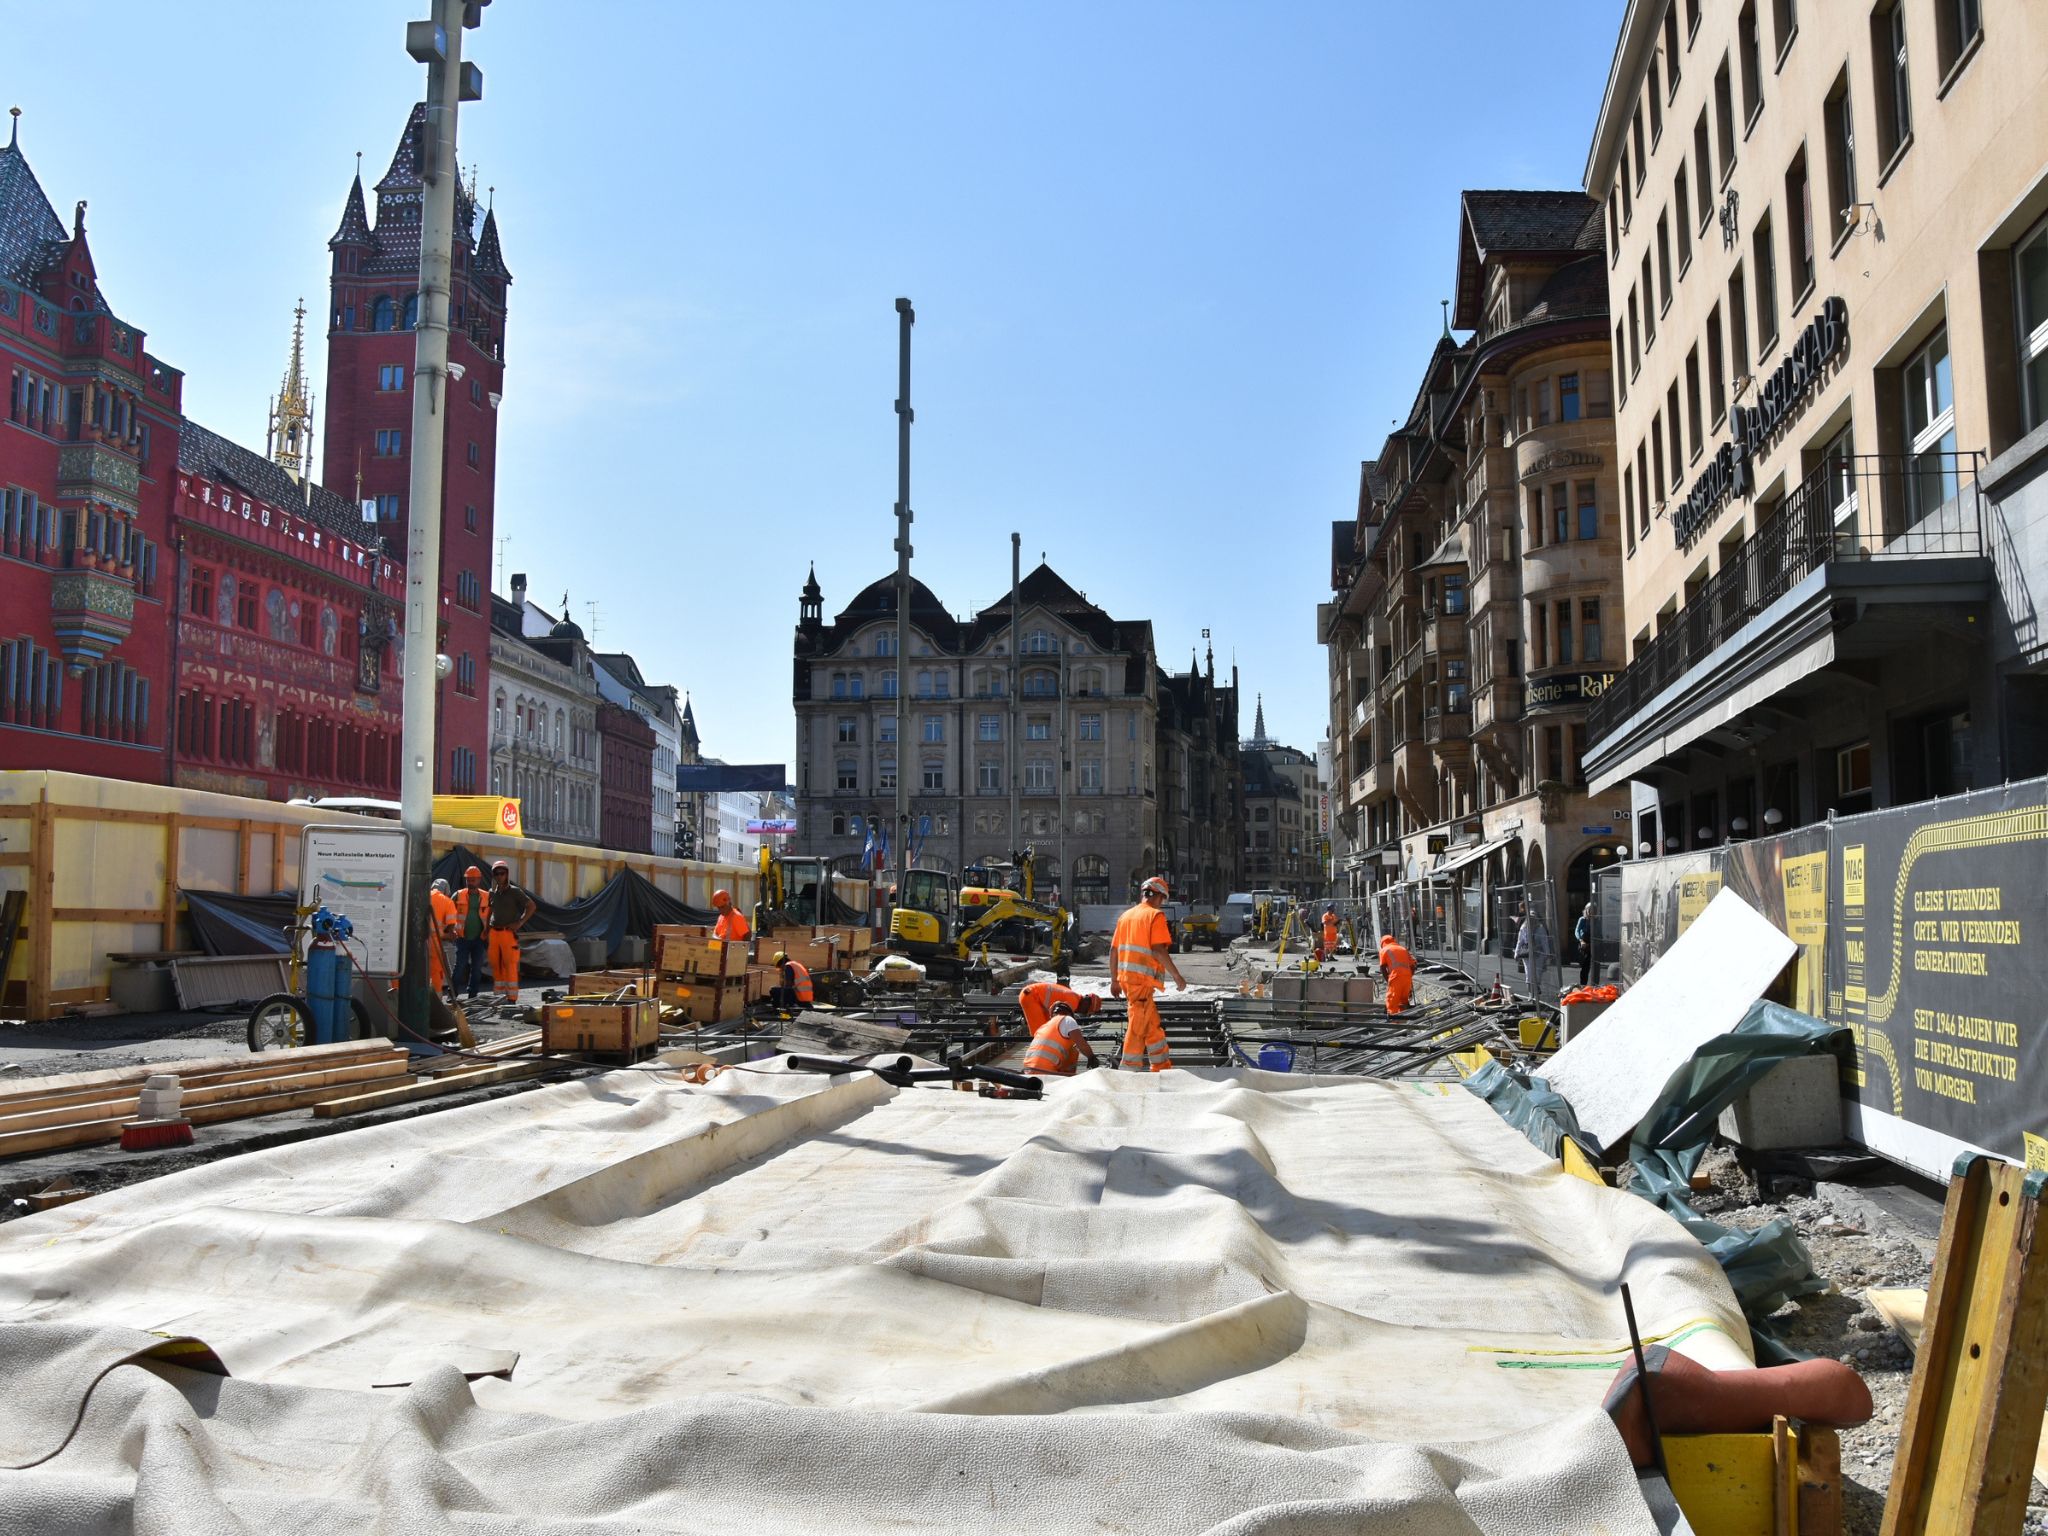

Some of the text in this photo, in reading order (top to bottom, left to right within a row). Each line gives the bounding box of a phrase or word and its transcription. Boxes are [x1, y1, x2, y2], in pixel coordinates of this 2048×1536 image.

[1671, 296, 1842, 550] BRASSERIE BASELSTAB
[1320, 794, 1328, 810] city
[1845, 859, 1863, 881] WAG
[1914, 887, 2001, 911] GLEISE VERBINDEN
[1913, 921, 2020, 944] ORTE. WIR VERBINDEN
[1846, 941, 1864, 963] WAG
[1914, 950, 1988, 976] GENERATIONEN.
[1914, 1009, 2018, 1047] SEIT 1946 BAUEN WIR
[1914, 1038, 2017, 1082] DIE INFRASTRUKTUR
[1914, 1067, 1977, 1105] VON MORGEN.
